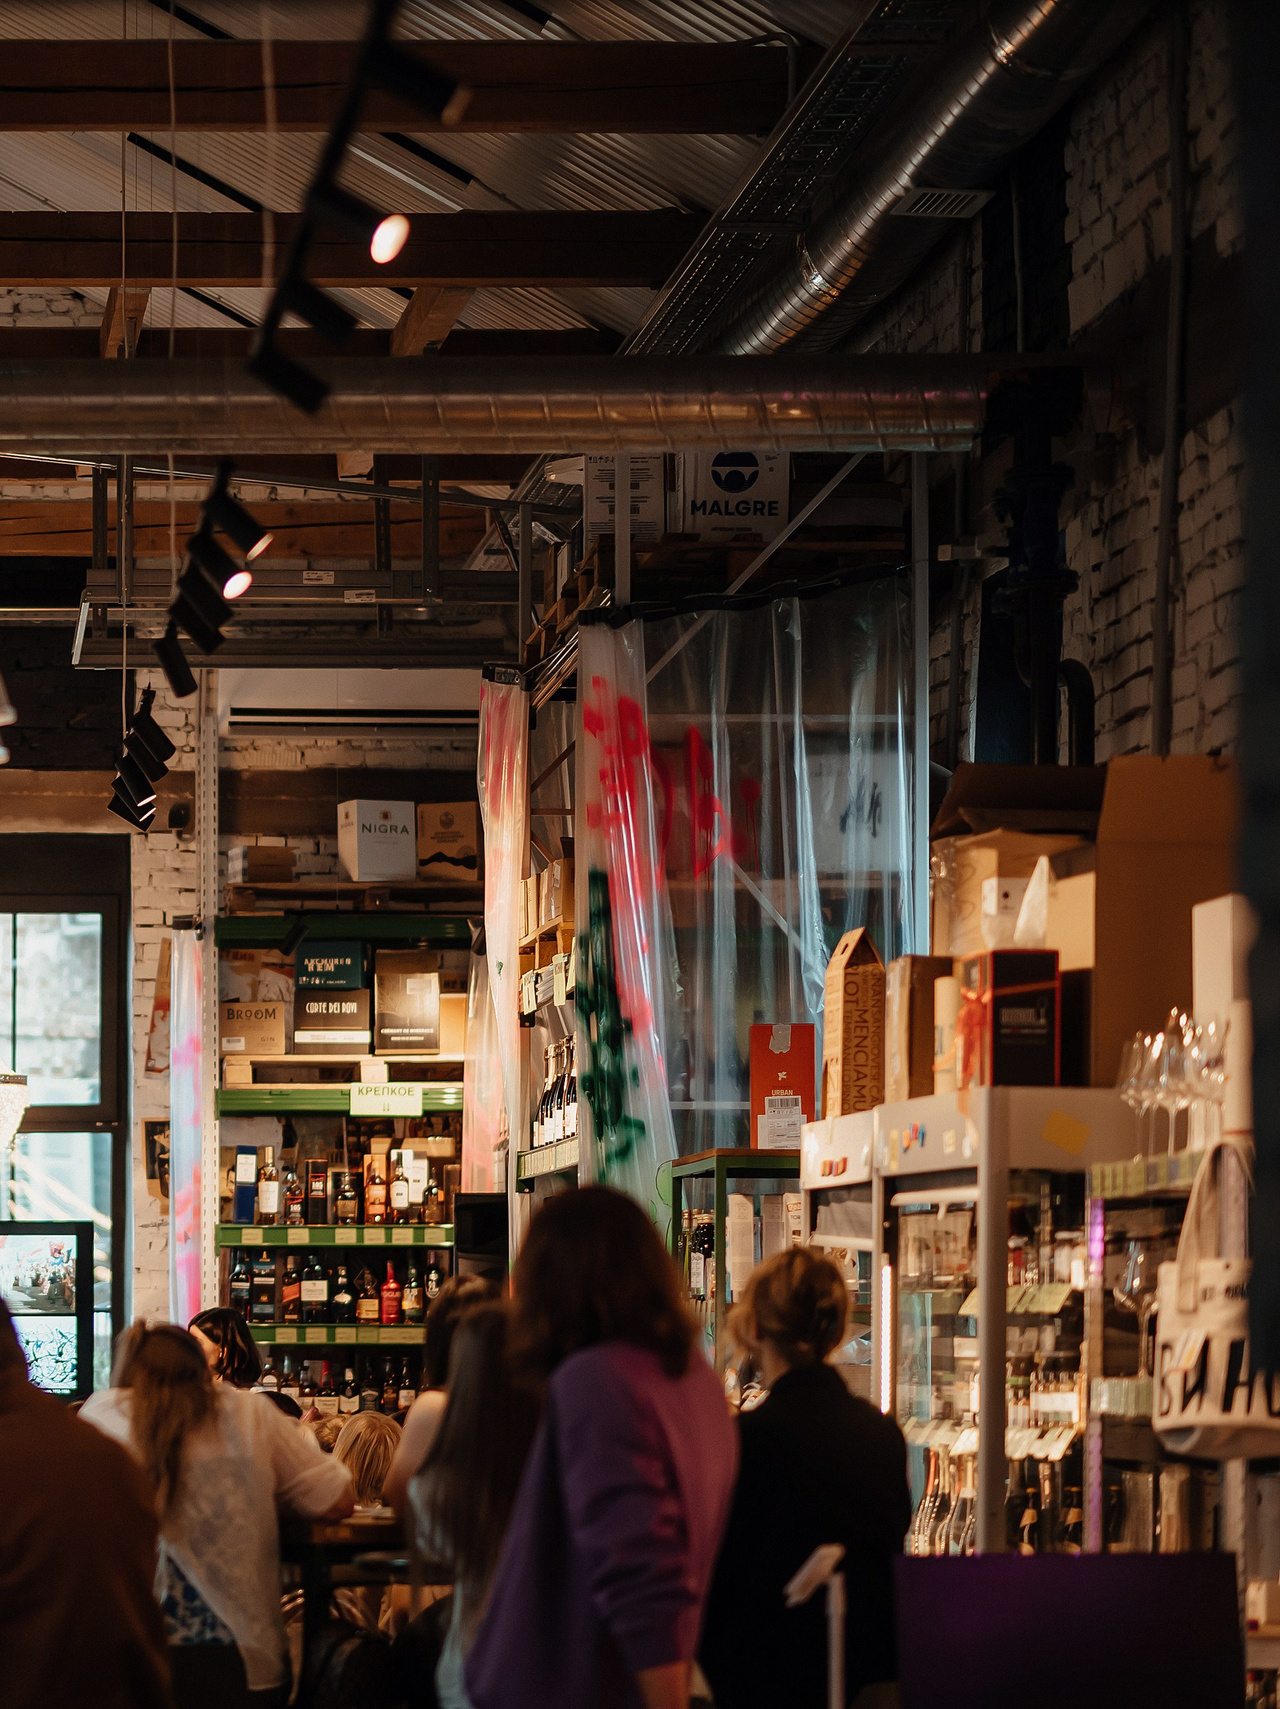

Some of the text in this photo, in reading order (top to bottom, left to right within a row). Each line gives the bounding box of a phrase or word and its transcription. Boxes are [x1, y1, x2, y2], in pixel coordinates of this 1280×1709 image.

[690, 500, 779, 517] MALGRE
[361, 823, 410, 835] NIGRA
[226, 1008, 277, 1020] BROOM
[305, 1002, 327, 1014] CORTE
[328, 1002, 340, 1014] DEI
[854, 1009, 869, 1082] MENCIA
[870, 1008, 881, 1083] SANGIOVESE
[358, 1086, 415, 1097] КРЕПКОЕ
[311, 1181, 324, 1189] 105
